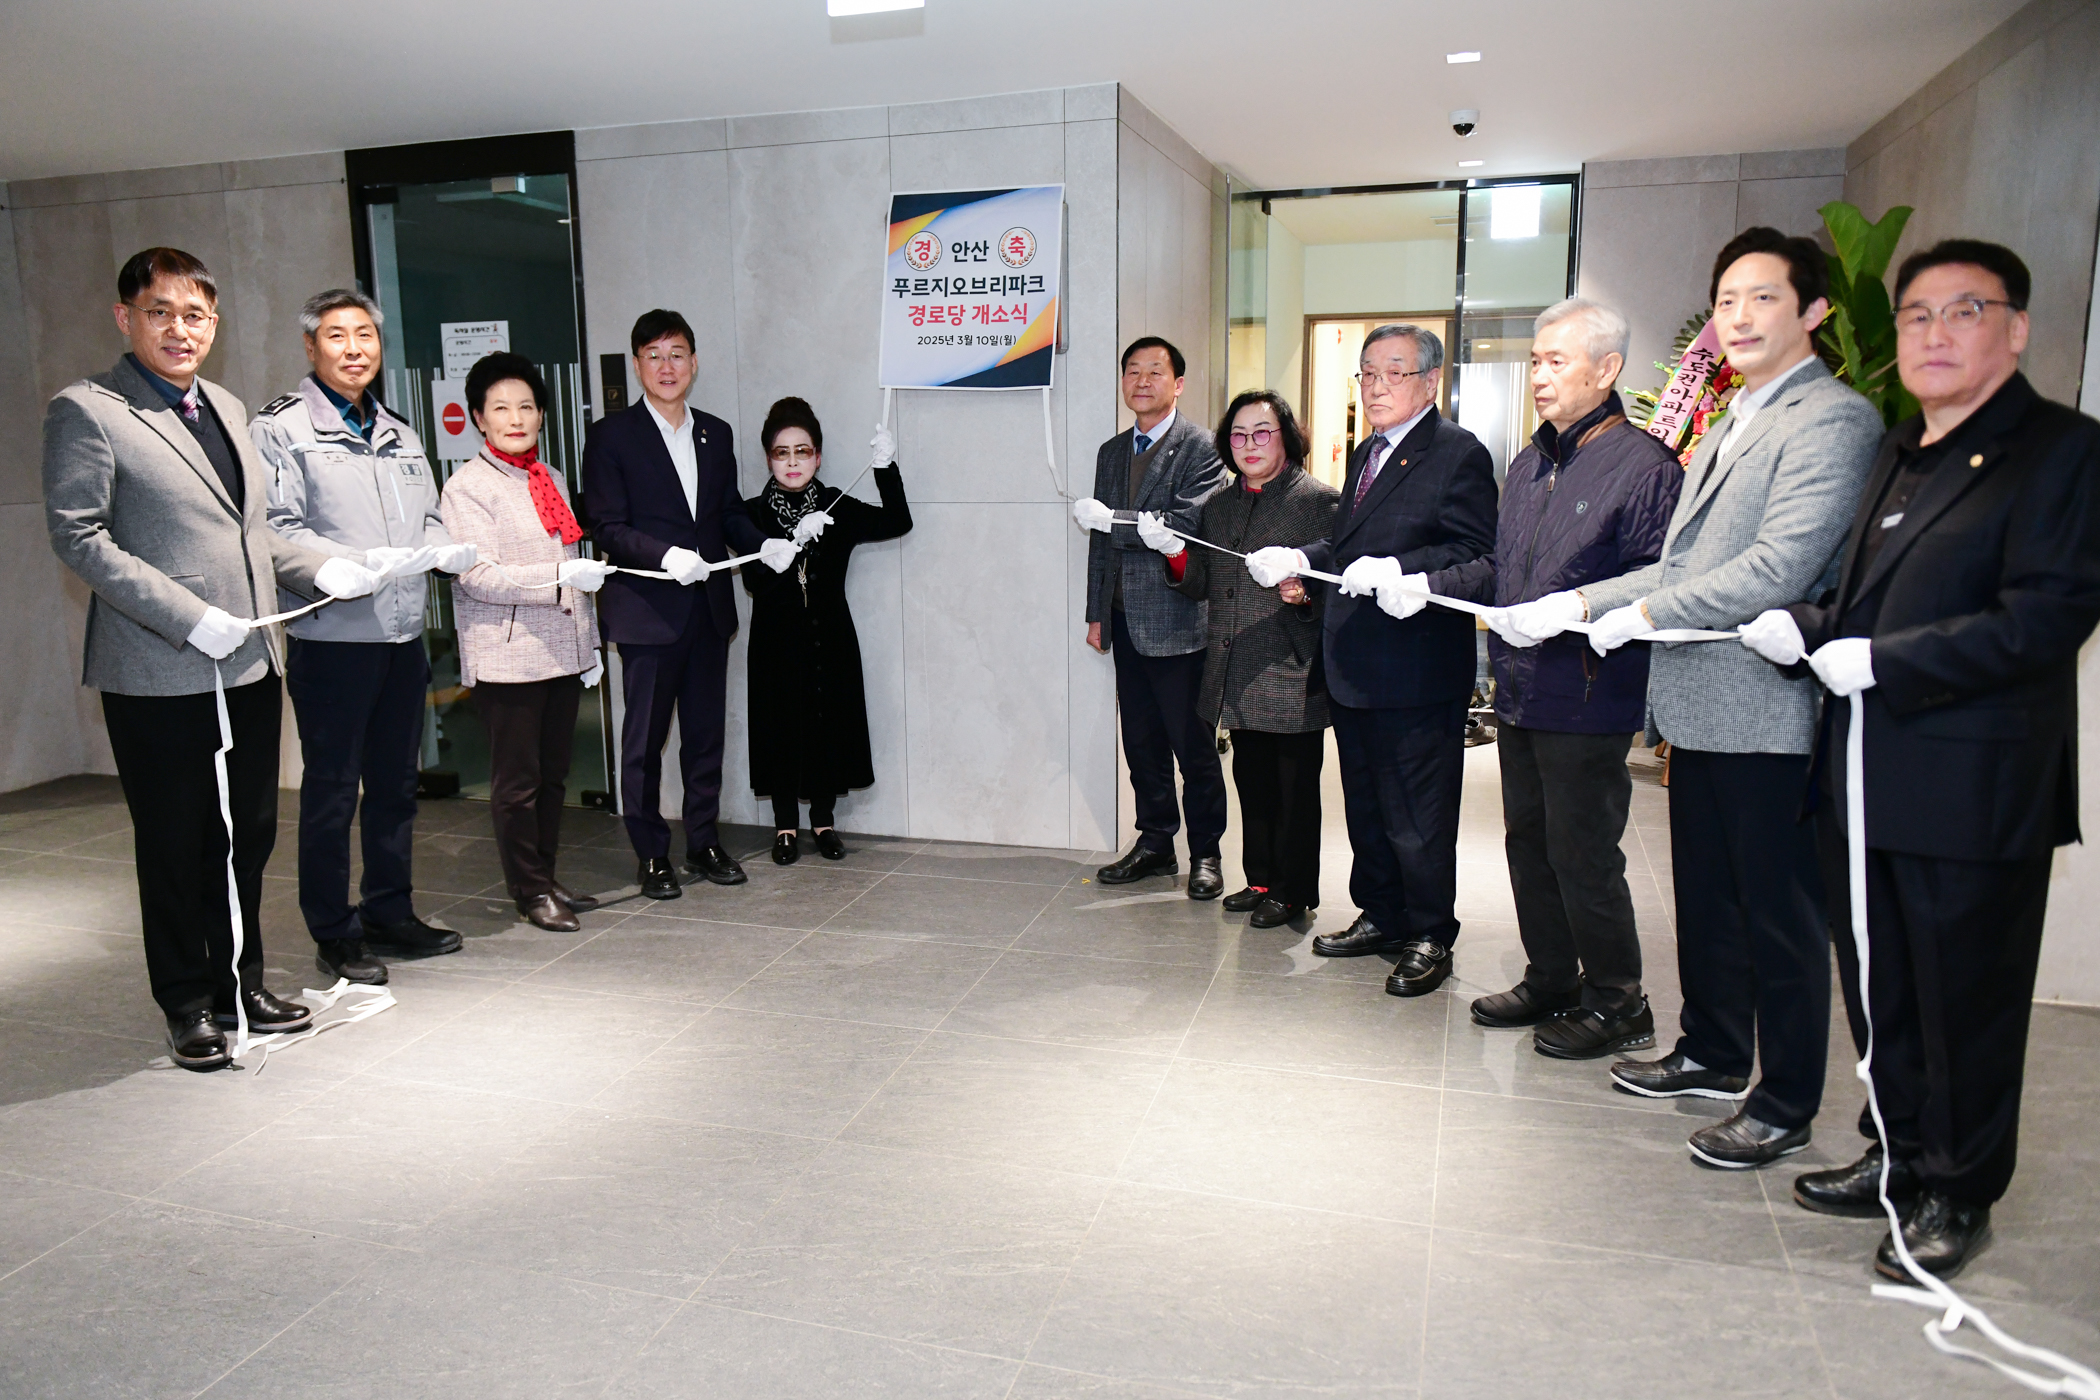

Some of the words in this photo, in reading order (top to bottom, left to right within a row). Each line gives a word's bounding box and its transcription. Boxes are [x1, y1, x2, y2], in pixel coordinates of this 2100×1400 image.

[914, 239, 931, 262] 경
[951, 240, 990, 263] 안산
[1008, 235, 1026, 258] 축
[891, 274, 1046, 299] 푸르지오브리파크
[908, 304, 966, 327] 경로당
[971, 302, 1028, 326] 개소식
[917, 334, 954, 346] 2025년
[956, 334, 973, 346] 3월
[975, 334, 1017, 346] 10일(월)
